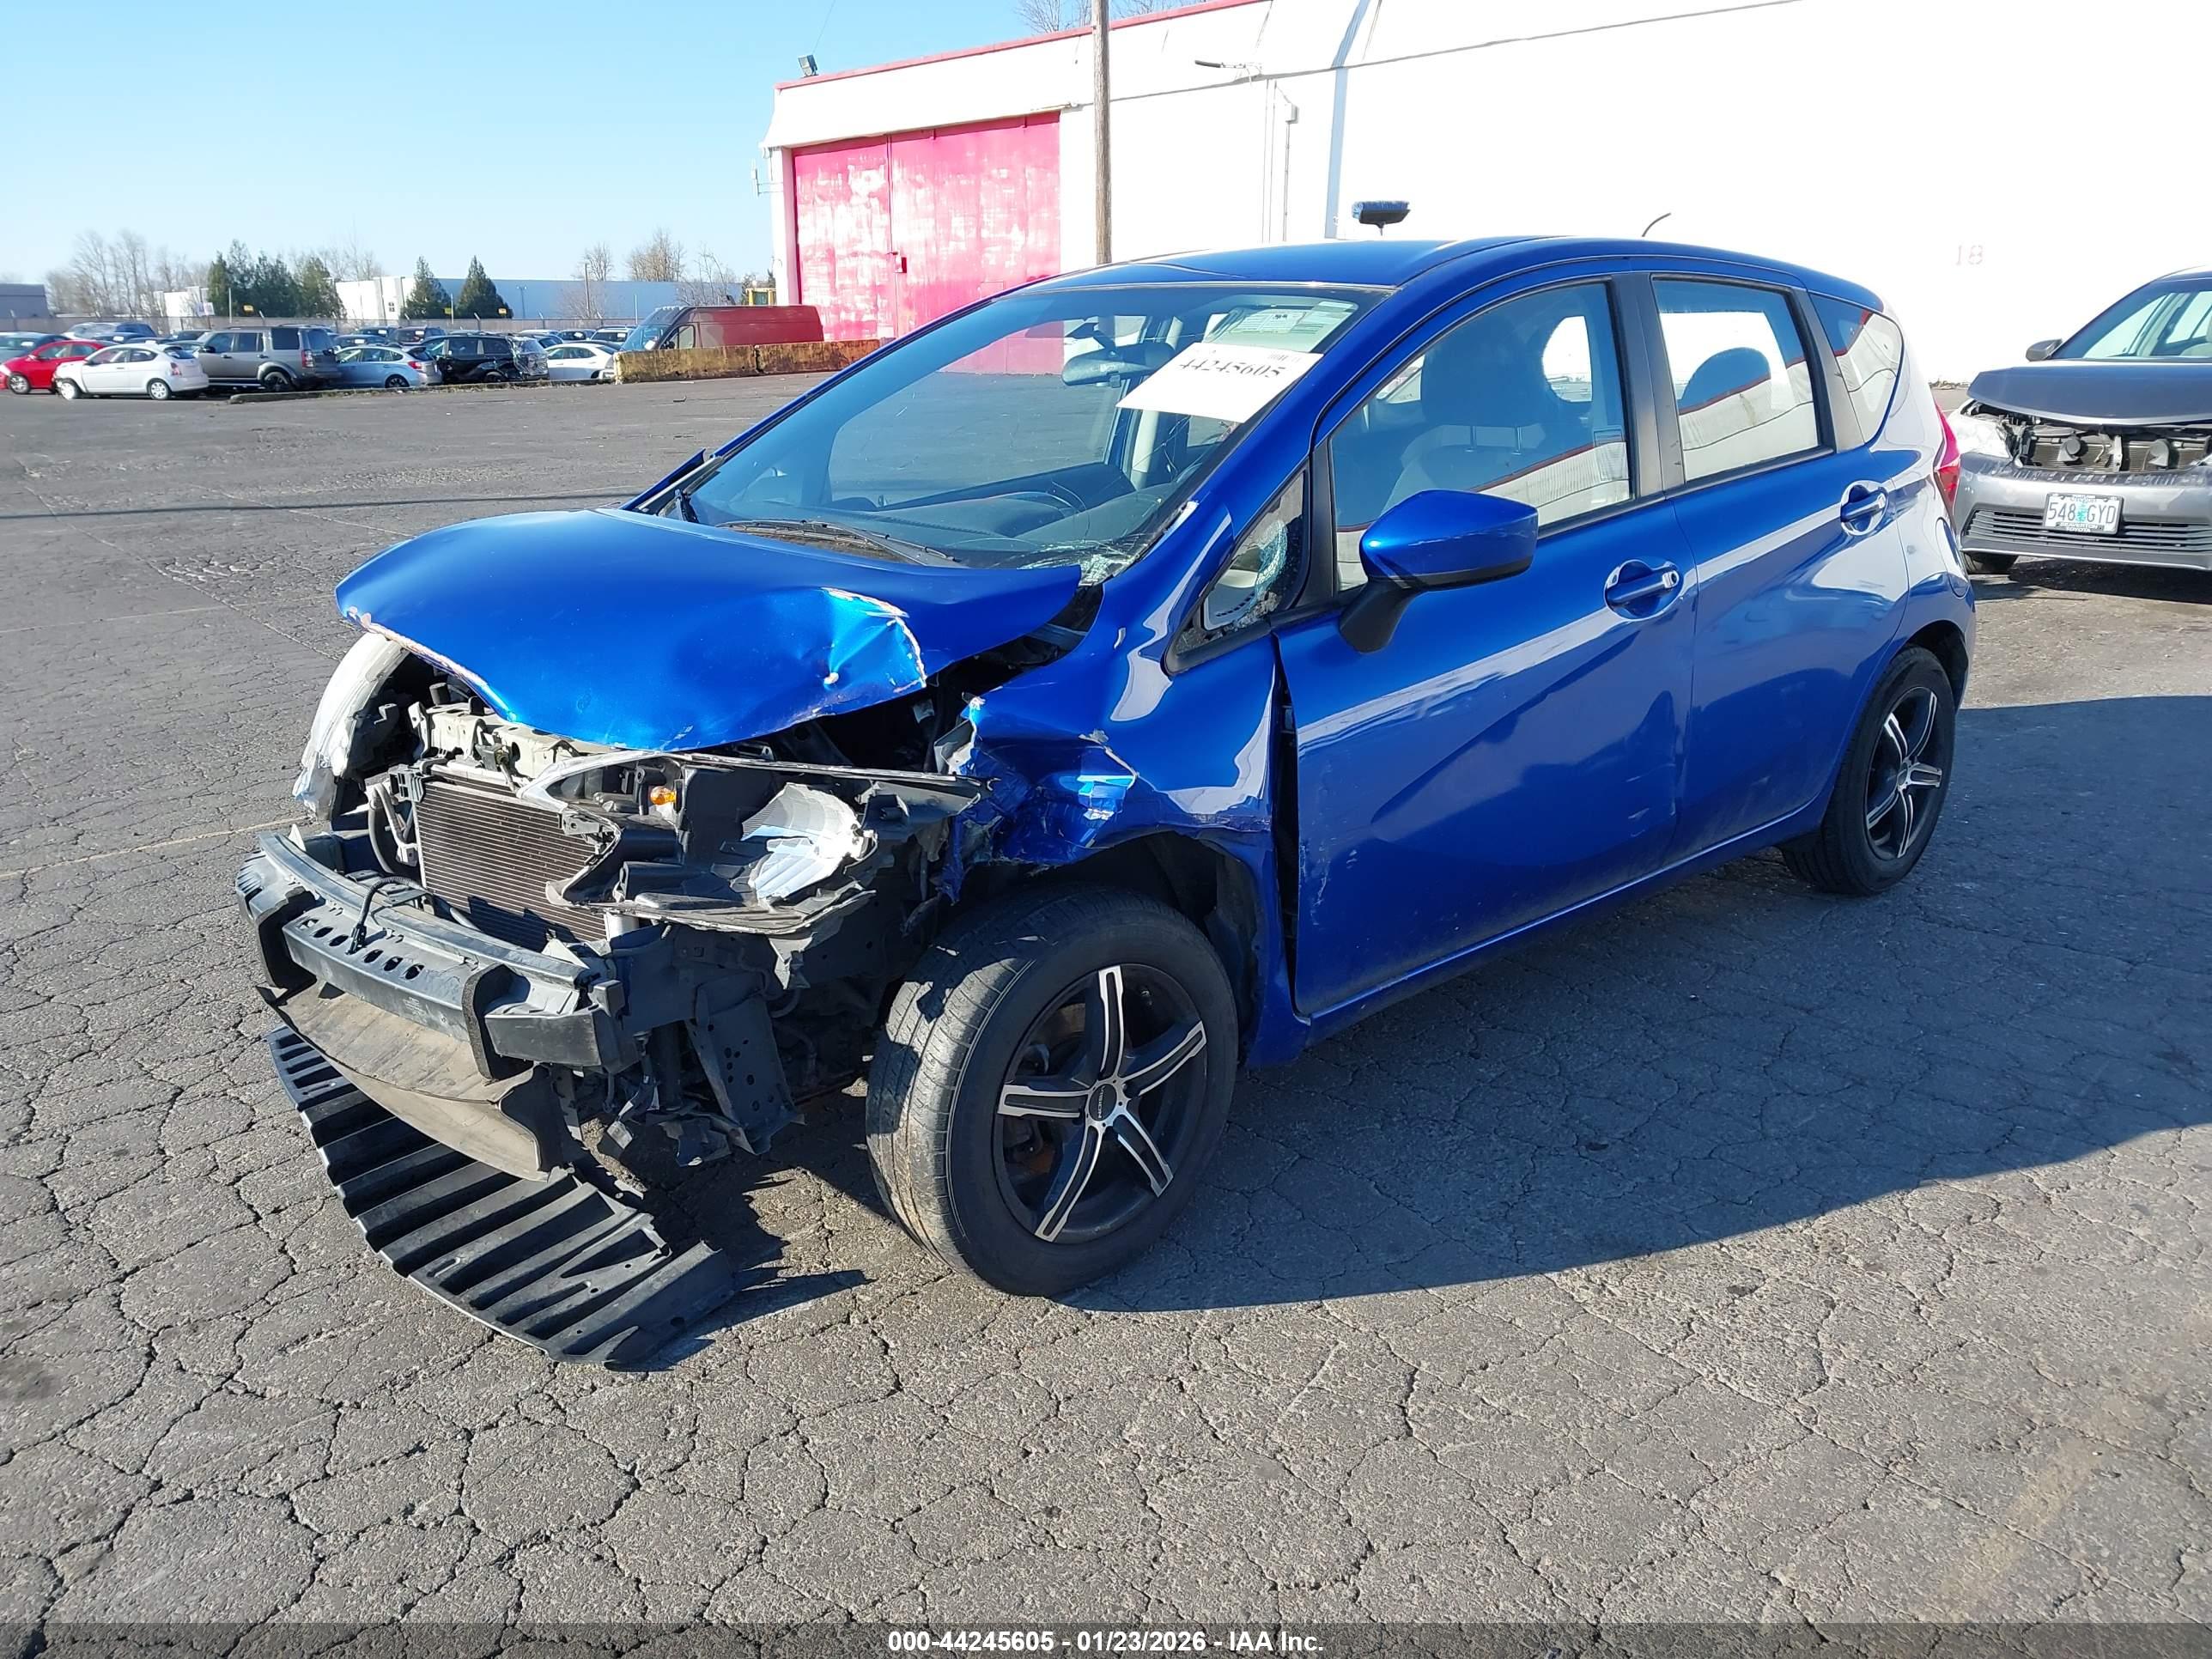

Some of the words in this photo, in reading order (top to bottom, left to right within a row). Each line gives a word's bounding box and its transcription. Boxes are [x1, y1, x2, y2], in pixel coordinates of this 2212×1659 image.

[1179, 357, 1286, 379] 44245605
[2047, 501, 2076, 521] 548
[2087, 504, 2117, 524] GYD
